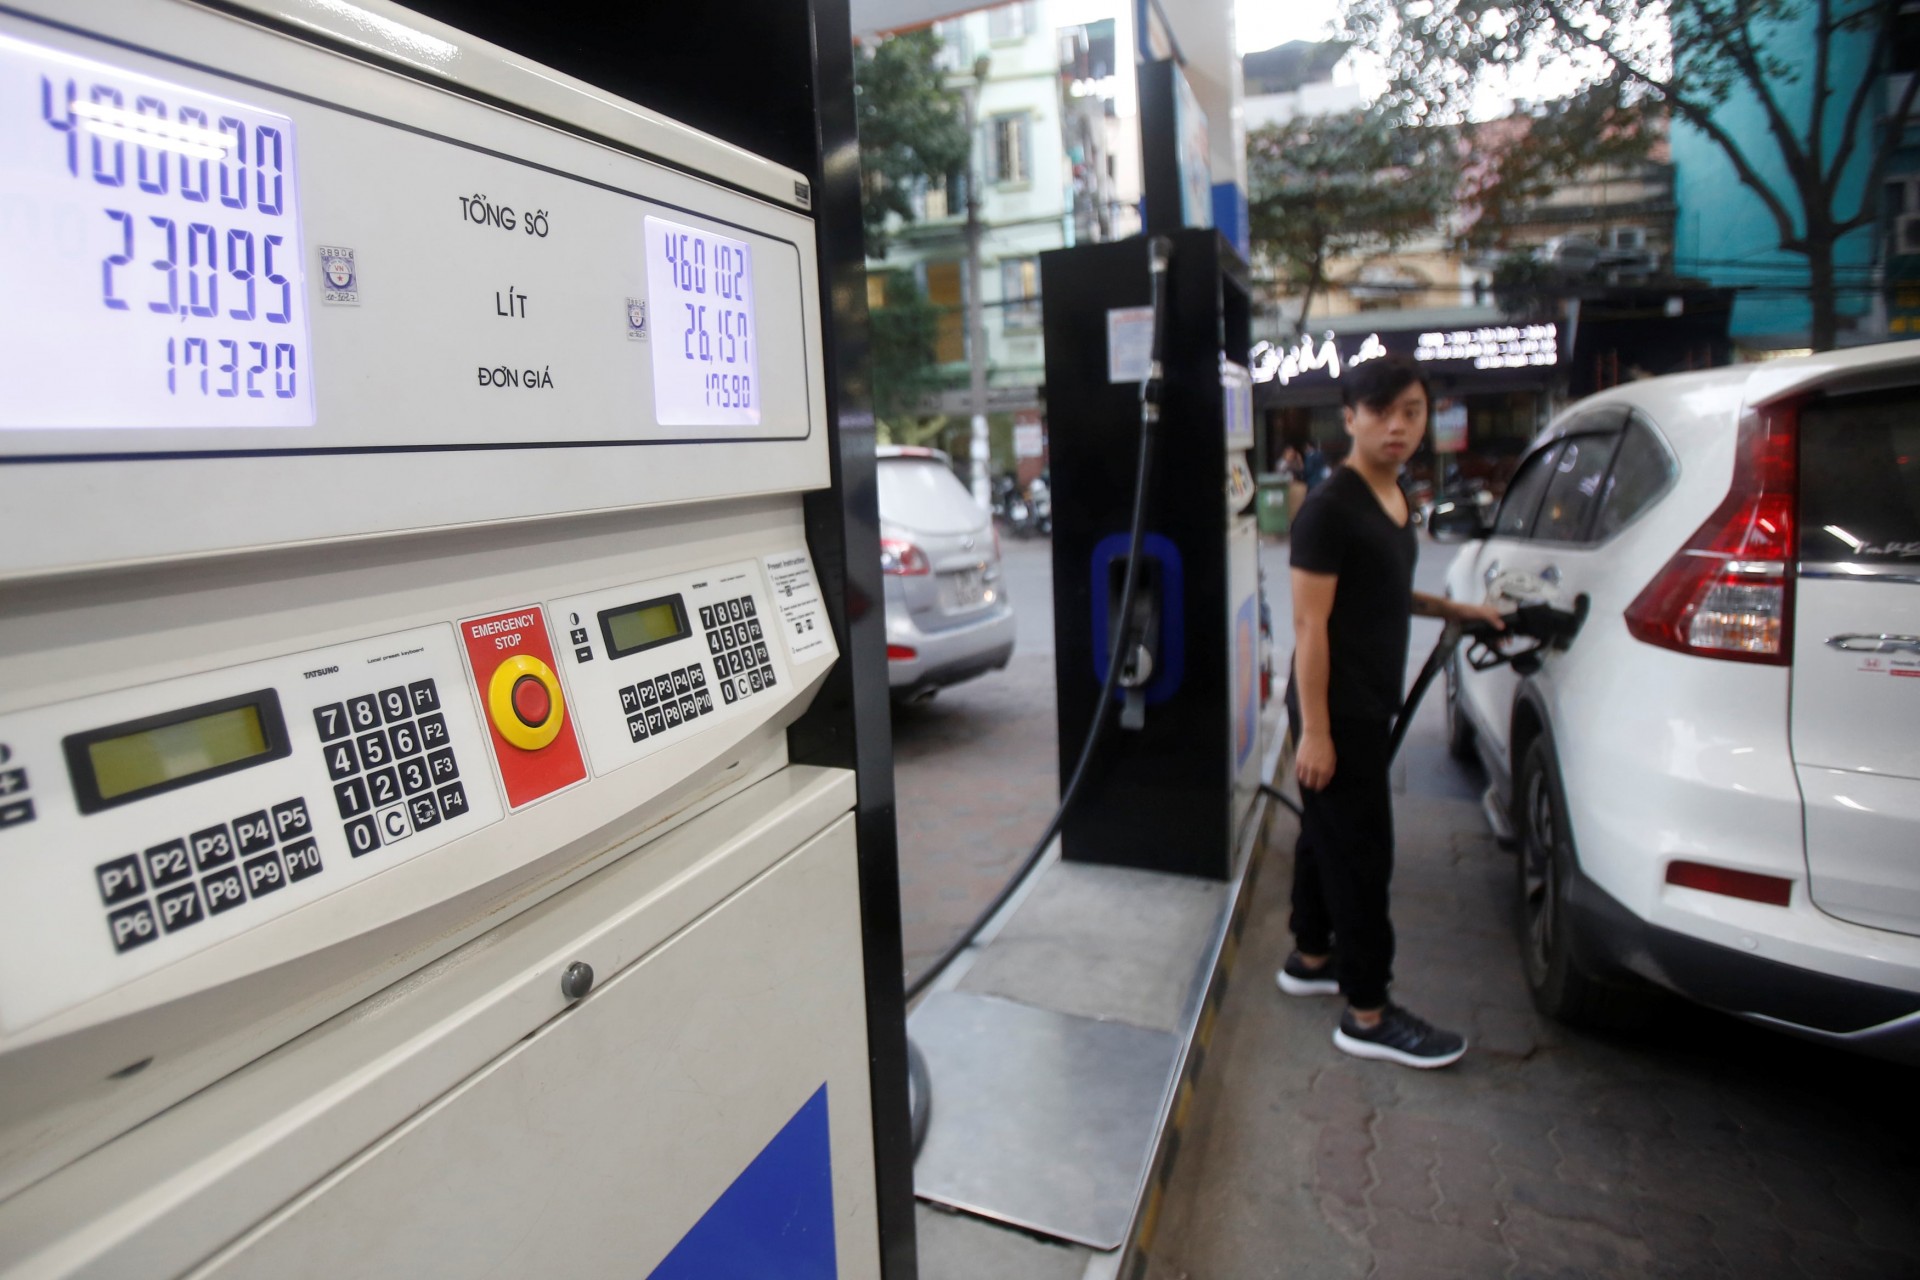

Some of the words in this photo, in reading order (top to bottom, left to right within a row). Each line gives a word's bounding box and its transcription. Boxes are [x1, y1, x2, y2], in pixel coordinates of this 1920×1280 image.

[40, 73, 284, 217] 400000
[459, 193, 516, 231] TỔNG
[524, 209, 549, 238] SỐ
[101, 208, 291, 324] 23,095
[665, 232, 744, 301] 460102
[496, 285, 527, 318] LÍT
[685, 303, 748, 365] 26,157
[167, 337, 297, 399] 17320
[478, 365, 519, 387] ĐƠN
[523, 365, 554, 389] GIÁ
[706, 373, 750, 408] 17590
[471, 613, 535, 639] EMERGENCY
[702, 609, 711, 626] 7
[718, 606, 727, 622] 8
[731, 602, 740, 618] 9
[744, 601, 753, 613] F1
[495, 633, 522, 650] STOP
[711, 634, 720, 651] 4
[724, 630, 733, 646] 5
[738, 626, 747, 642] 6
[750, 624, 760, 636] F2
[303, 665, 340, 679] TATSUNO
[718, 659, 726, 676] 1
[731, 655, 740, 671] 2
[744, 650, 754, 666] 3
[757, 648, 767, 659] F3
[622, 691, 637, 708] P1
[640, 686, 655, 702] P2
[657, 680, 672, 695] P3
[674, 674, 688, 690] P4
[690, 669, 703, 684] P5
[724, 684, 734, 701] 0
[738, 678, 748, 695] C
[764, 671, 774, 682] F4
[321, 709, 337, 736] 7
[356, 701, 374, 726] 8
[387, 692, 403, 717] 9
[415, 688, 433, 706] F1
[630, 720, 646, 737] P6
[648, 713, 661, 730] P7
[665, 707, 679, 723] P8
[681, 700, 695, 716] P9
[696, 694, 712, 710] P10
[335, 747, 352, 773] 4
[366, 738, 383, 763] 5
[399, 728, 413, 753] 6
[424, 723, 444, 741] F2
[343, 786, 359, 811] 1
[376, 776, 394, 801] 2
[406, 765, 423, 789] 3
[434, 757, 453, 776] F3
[353, 824, 371, 851] 0
[385, 811, 405, 837] C
[443, 791, 463, 811] F4
[102, 865, 138, 897] P1
[151, 849, 187, 880] P2
[196, 834, 229, 862] P3
[237, 819, 269, 847] P4
[277, 806, 307, 833] P5
[113, 913, 152, 945] P6
[162, 892, 196, 925] P7
[207, 876, 241, 907] P8
[249, 862, 280, 890] P9
[285, 845, 320, 875] P10
